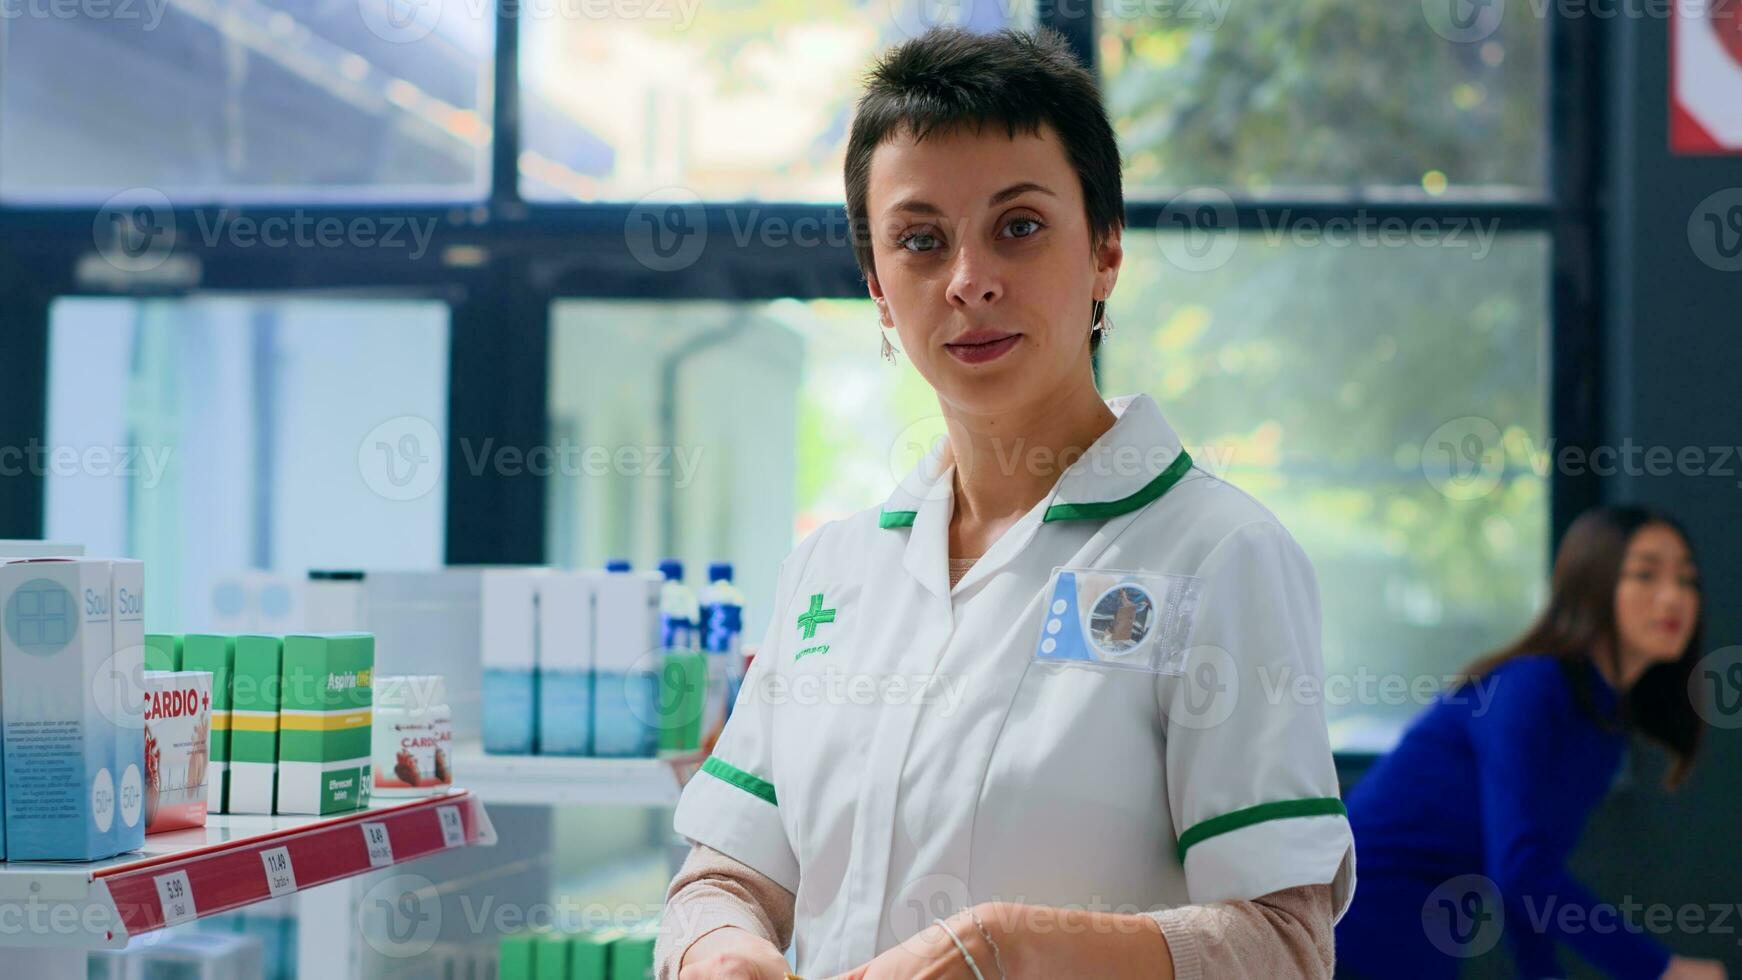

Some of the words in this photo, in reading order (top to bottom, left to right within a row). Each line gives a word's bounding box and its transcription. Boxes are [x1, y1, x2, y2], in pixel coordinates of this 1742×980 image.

[85, 588, 109, 616] Soul
[119, 587, 143, 615] Soul
[327, 671, 357, 692] Aspirin
[144, 688, 199, 720] CARDIO
[360, 774, 371, 796] 30
[122, 785, 140, 809] 50+
[268, 853, 287, 873] 11.49
[166, 878, 184, 900] 5.99
